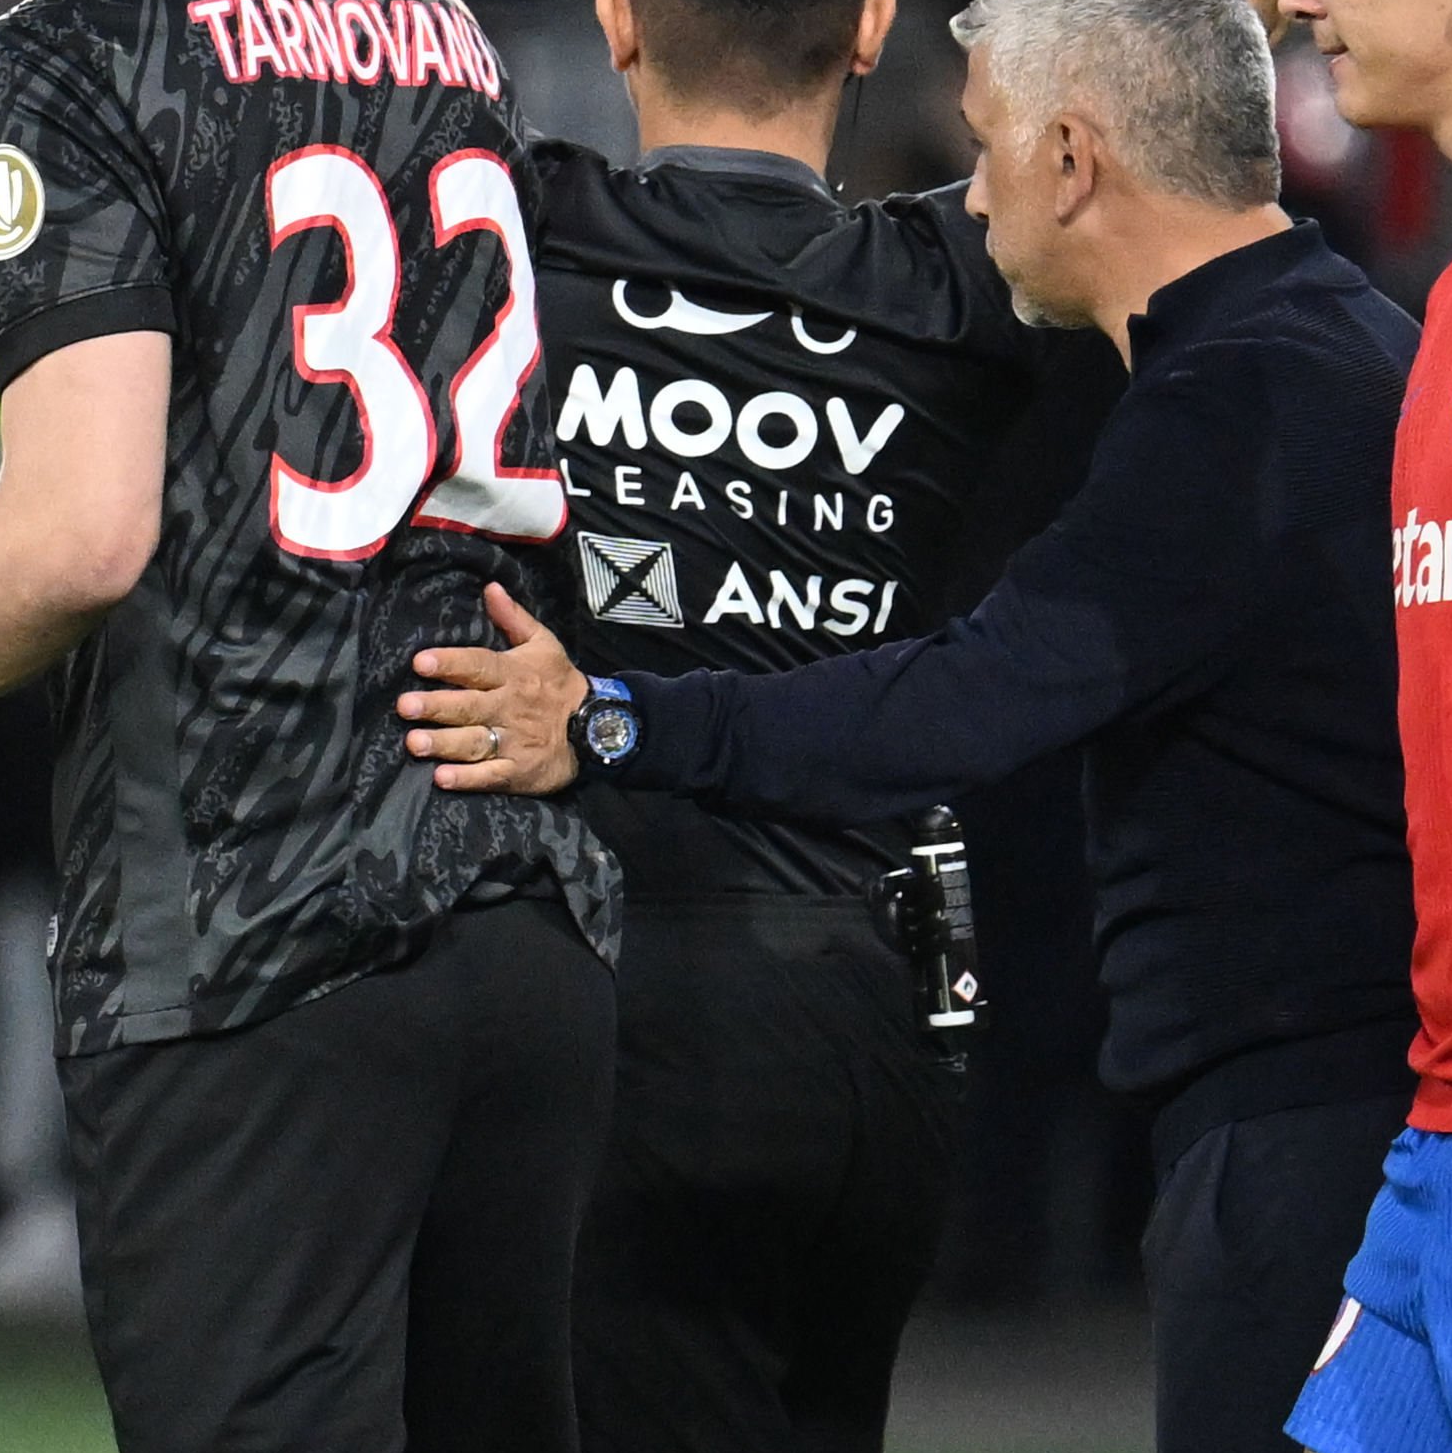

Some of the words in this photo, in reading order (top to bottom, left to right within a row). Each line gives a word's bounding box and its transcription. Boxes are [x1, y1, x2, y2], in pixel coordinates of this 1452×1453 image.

[266, 144, 569, 562] 32
[555, 363, 906, 475] MOOV
[559, 458, 895, 533] LEASING
[703, 560, 899, 636] ANSI
